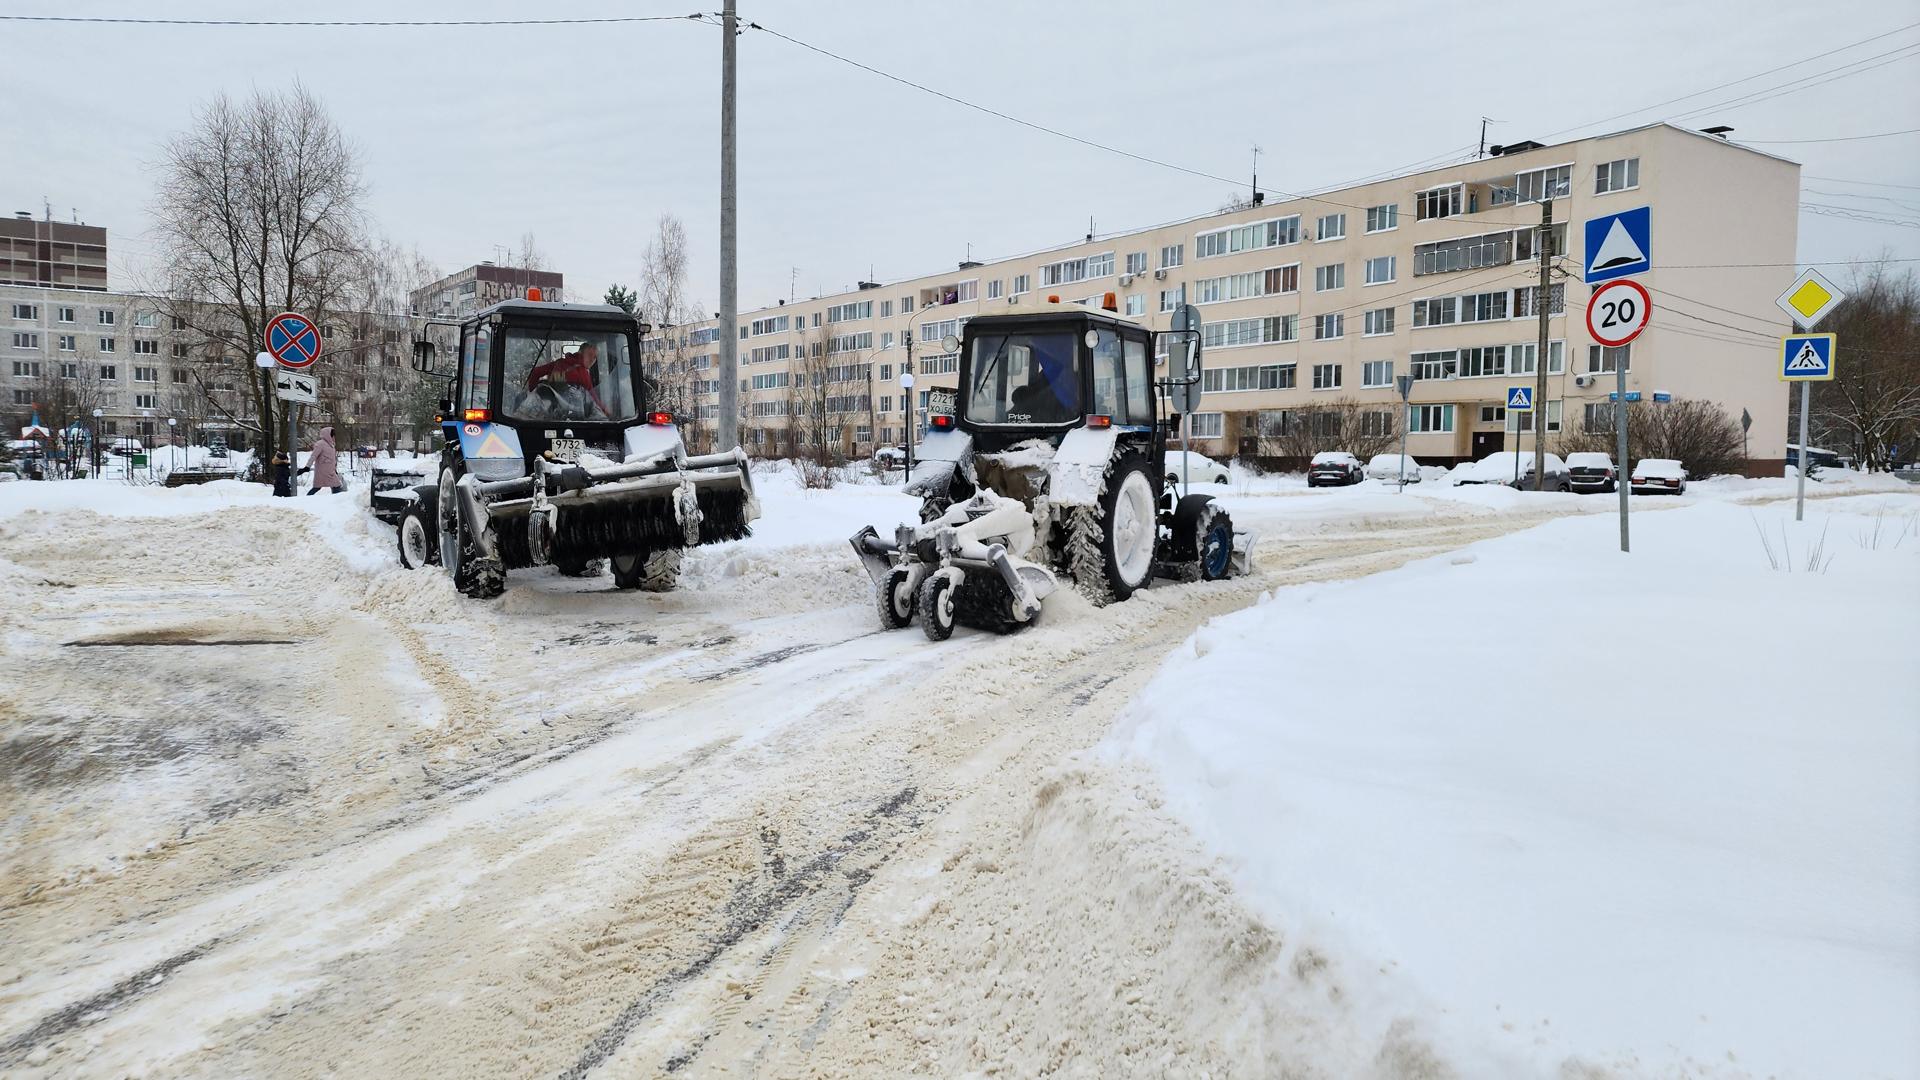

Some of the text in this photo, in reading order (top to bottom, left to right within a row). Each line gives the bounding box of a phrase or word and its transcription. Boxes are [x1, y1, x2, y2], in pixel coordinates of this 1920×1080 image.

[1601, 298, 1635, 328] 20
[932, 393, 953, 404] 2721
[555, 439, 580, 449] 9732
